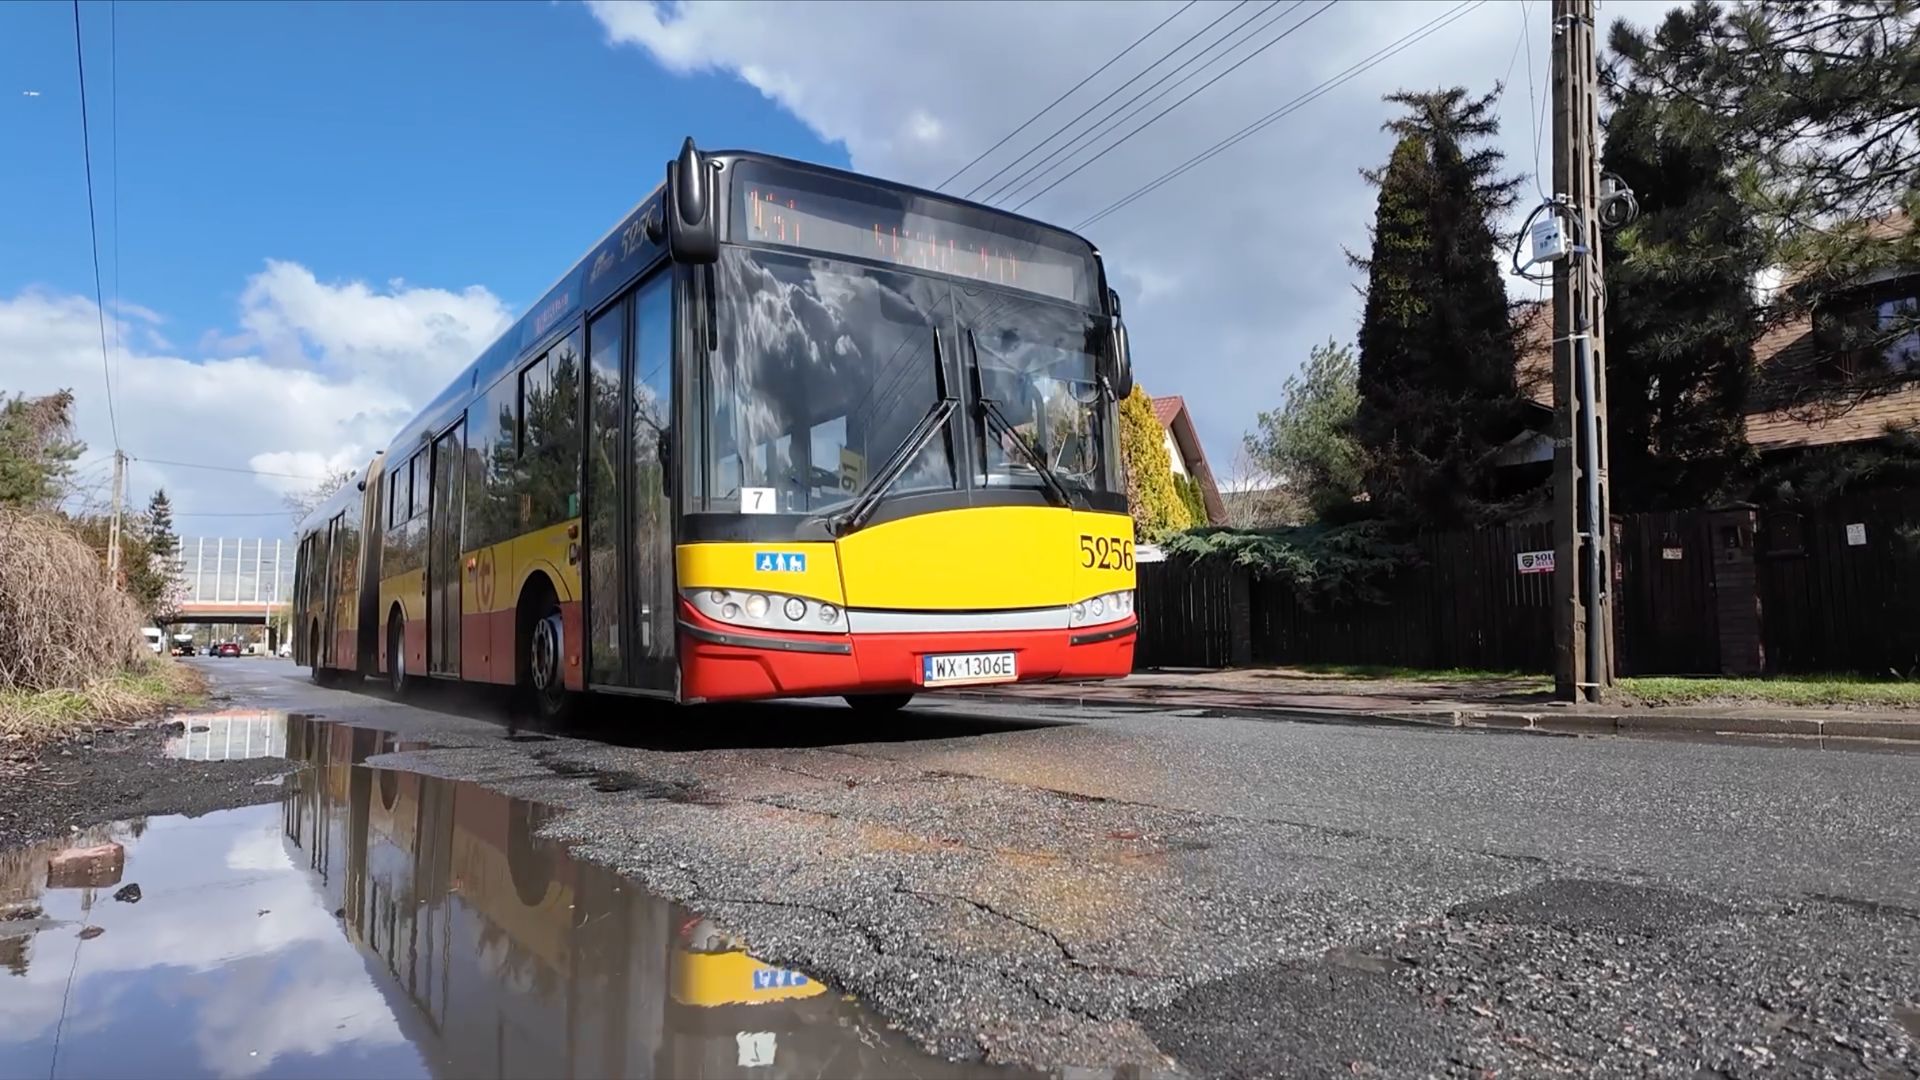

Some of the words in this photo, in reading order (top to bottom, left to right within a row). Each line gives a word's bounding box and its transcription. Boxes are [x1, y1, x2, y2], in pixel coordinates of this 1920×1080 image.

[752, 491, 763, 510] 7
[1080, 534, 1134, 572] 5256
[936, 658, 957, 678] WX
[965, 655, 1012, 676] 1306E
